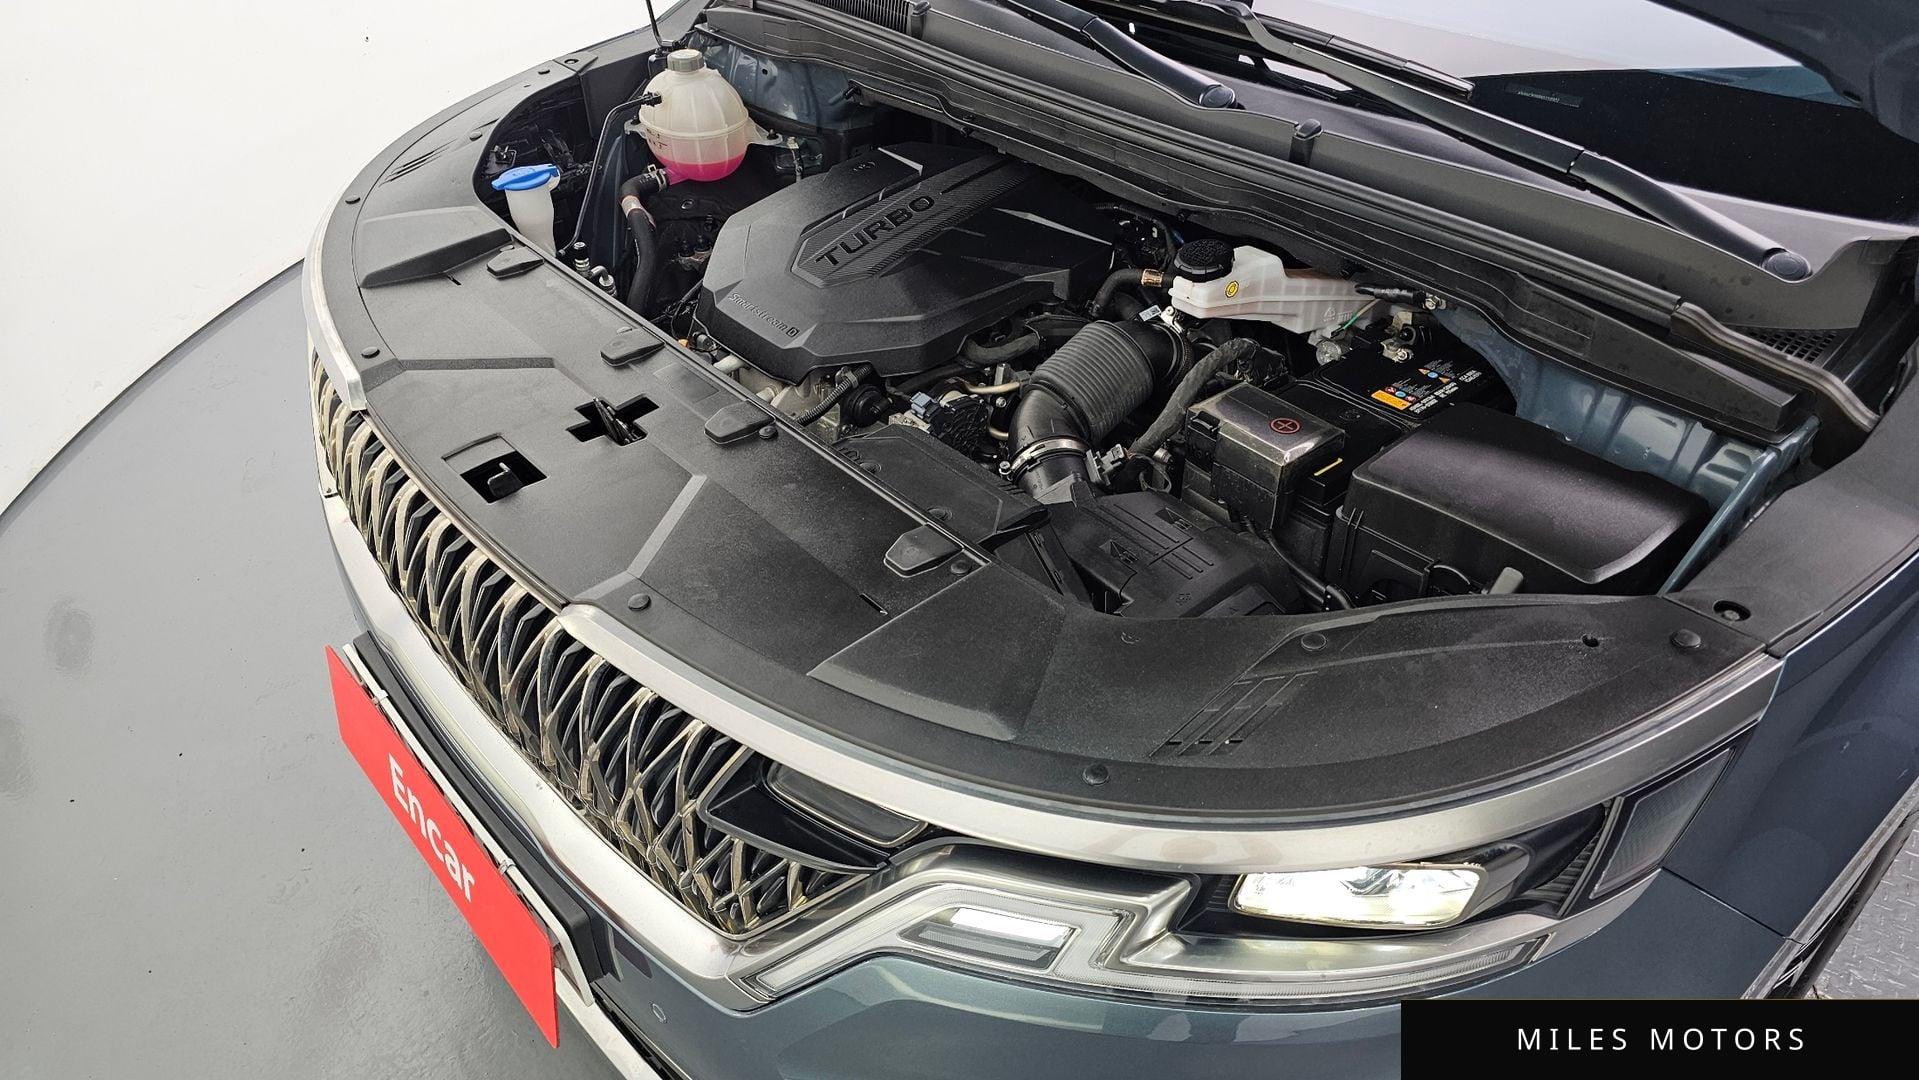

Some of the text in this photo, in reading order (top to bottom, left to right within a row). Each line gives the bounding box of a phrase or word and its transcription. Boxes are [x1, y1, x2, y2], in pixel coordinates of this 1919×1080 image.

[814, 196, 935, 266] TURBO
[728, 292, 788, 332] Smartstream
[388, 752, 475, 903] Encar
